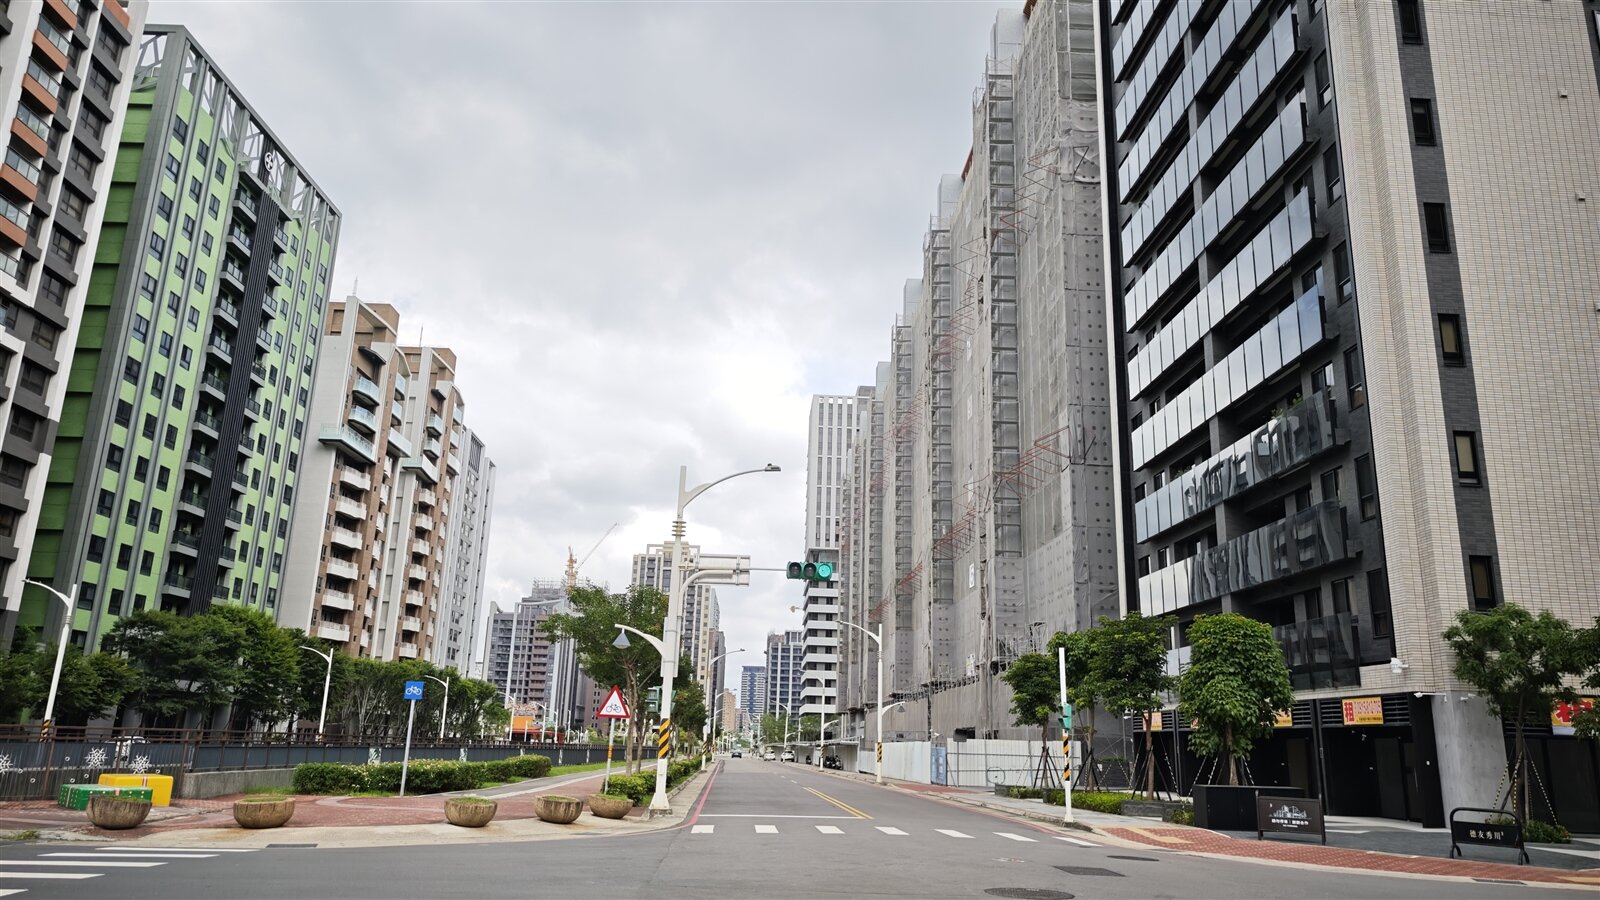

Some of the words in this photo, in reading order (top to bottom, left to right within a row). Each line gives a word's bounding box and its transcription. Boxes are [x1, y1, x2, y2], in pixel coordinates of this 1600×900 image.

[1344, 701, 1354, 722] 租
[1469, 829, 1501, 840] 德友秀川
